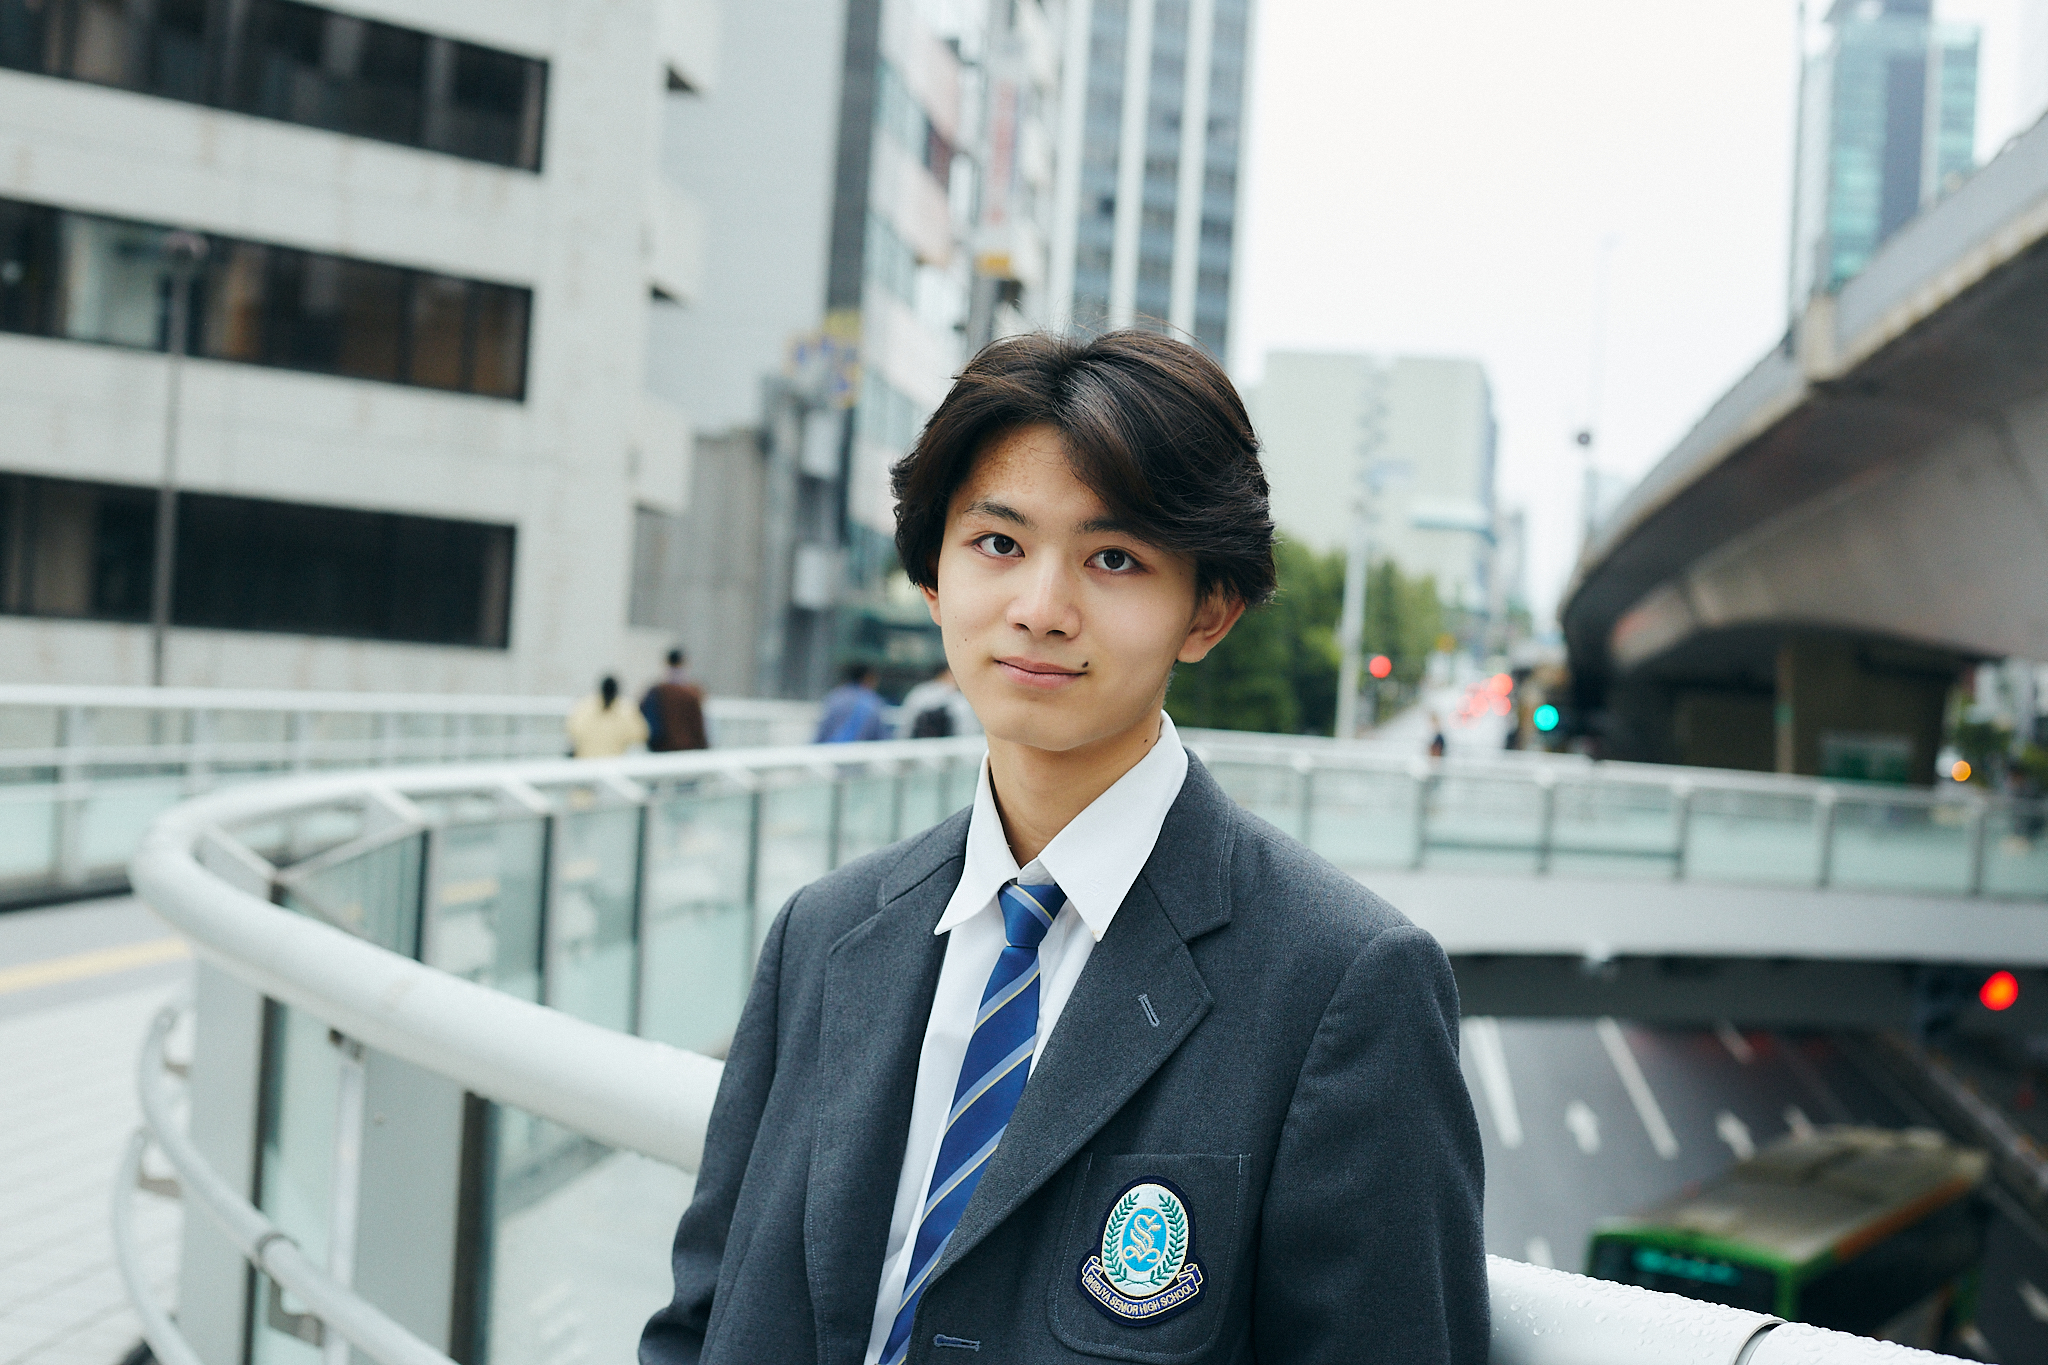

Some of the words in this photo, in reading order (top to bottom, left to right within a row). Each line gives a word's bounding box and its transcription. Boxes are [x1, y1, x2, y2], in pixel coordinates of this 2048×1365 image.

[1085, 1274, 1112, 1303] SHIBUYA
[1109, 1295, 1139, 1316] SENIOR
[1139, 1299, 1161, 1315] HIGH
[1160, 1283, 1195, 1307] SCHOOL
